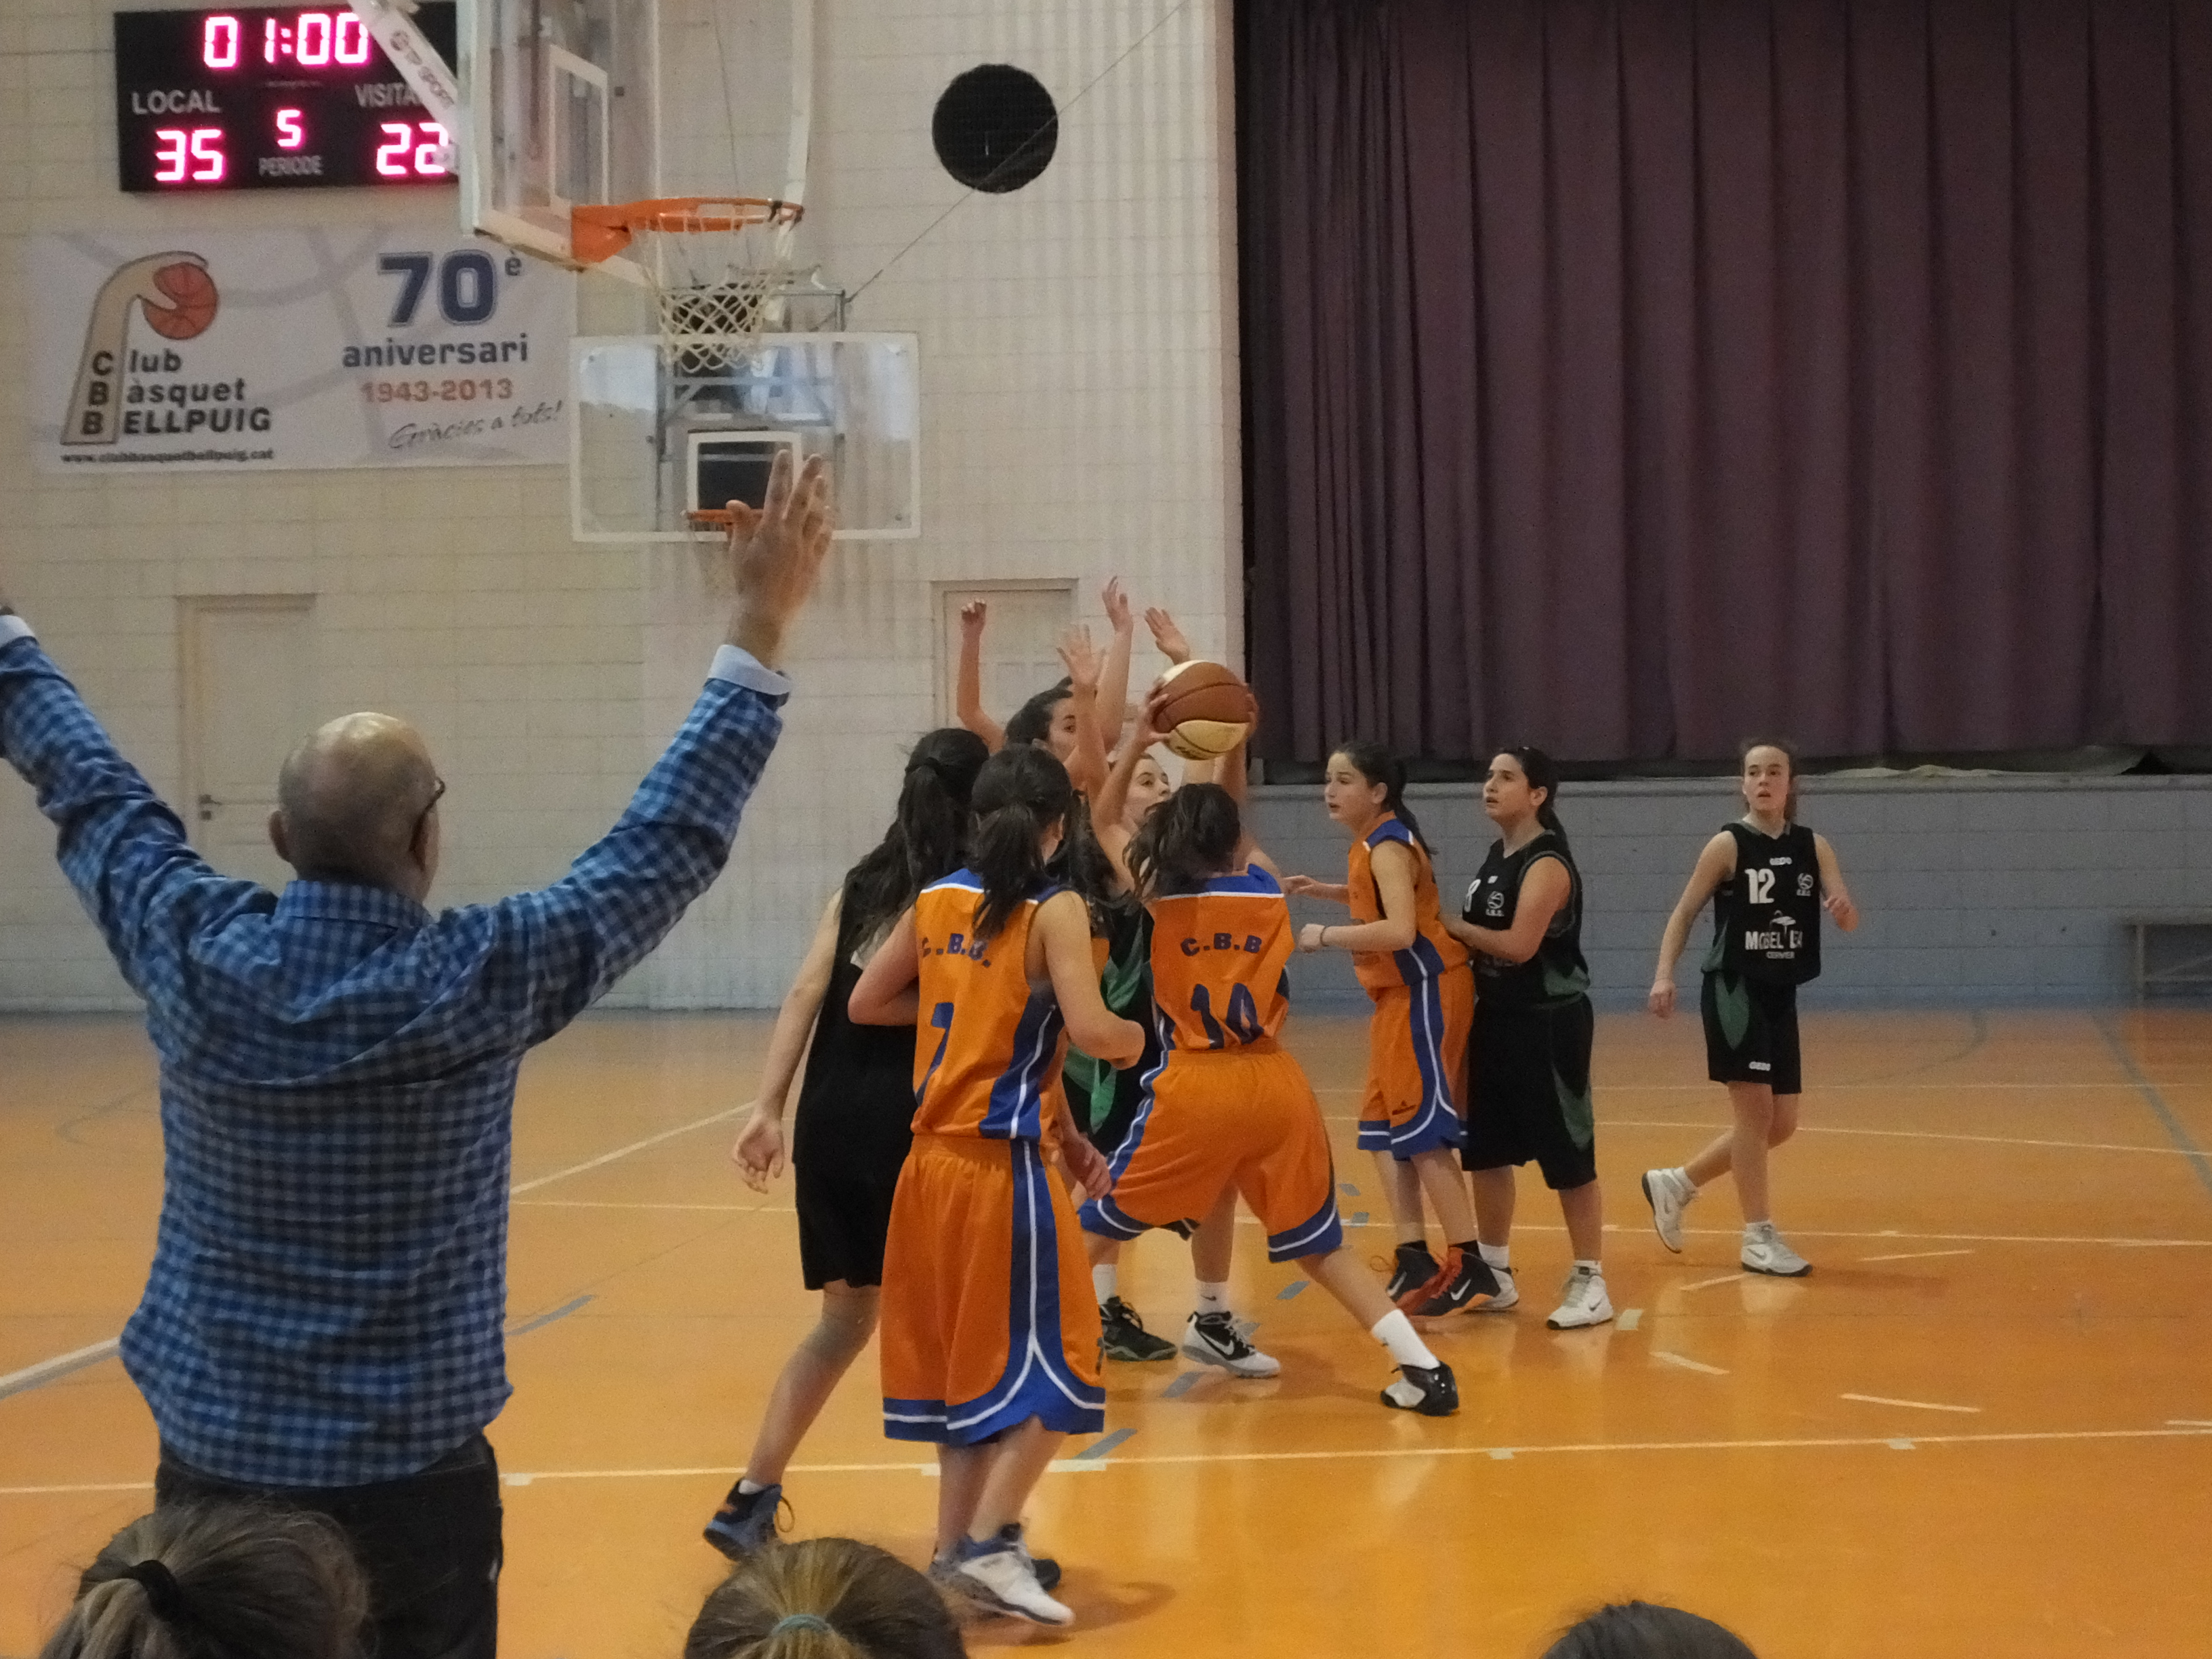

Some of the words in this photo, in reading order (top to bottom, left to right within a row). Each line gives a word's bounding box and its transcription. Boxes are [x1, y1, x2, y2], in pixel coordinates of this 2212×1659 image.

[131, 89, 222, 115] LOCAL
[155, 128, 224, 182] 35
[375, 122, 449, 176] 22
[342, 333, 529, 368] aniversari
[361, 377, 513, 403] 1943-2013
[1744, 868, 1776, 905] 12
[1190, 982, 1265, 1050] 10
